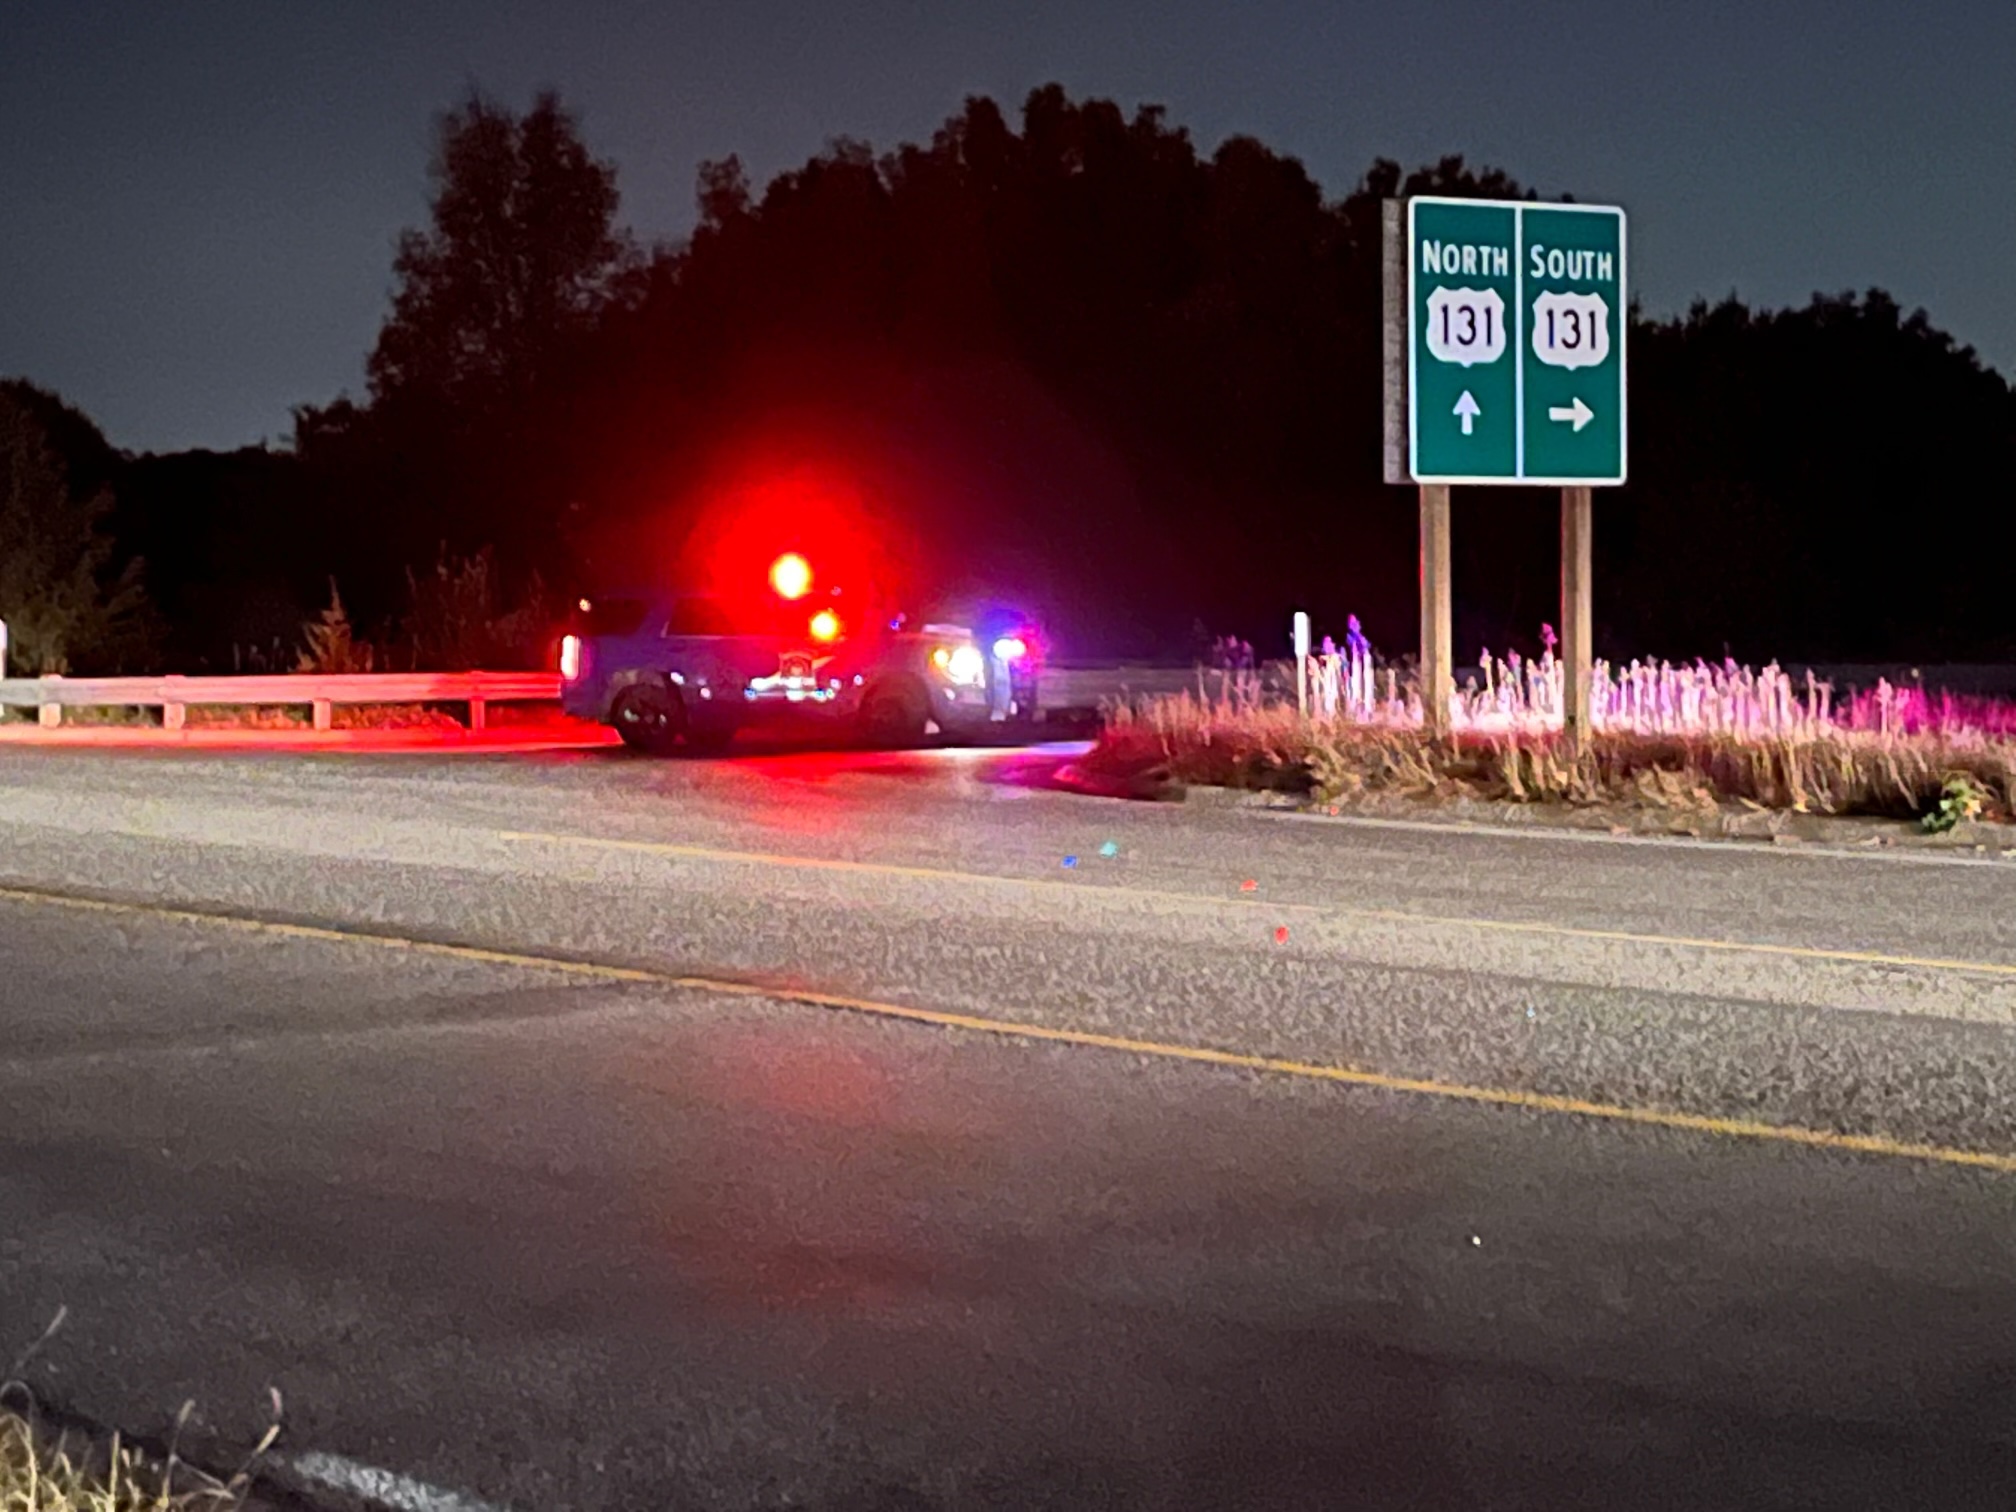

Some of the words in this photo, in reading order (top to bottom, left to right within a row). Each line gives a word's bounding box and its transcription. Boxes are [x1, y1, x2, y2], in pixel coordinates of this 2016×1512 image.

[1422, 239, 1508, 276] NORTH
[1530, 244, 1613, 281] SOUTH
[1441, 303, 1492, 347] 131
[1546, 308, 1596, 350] 131
